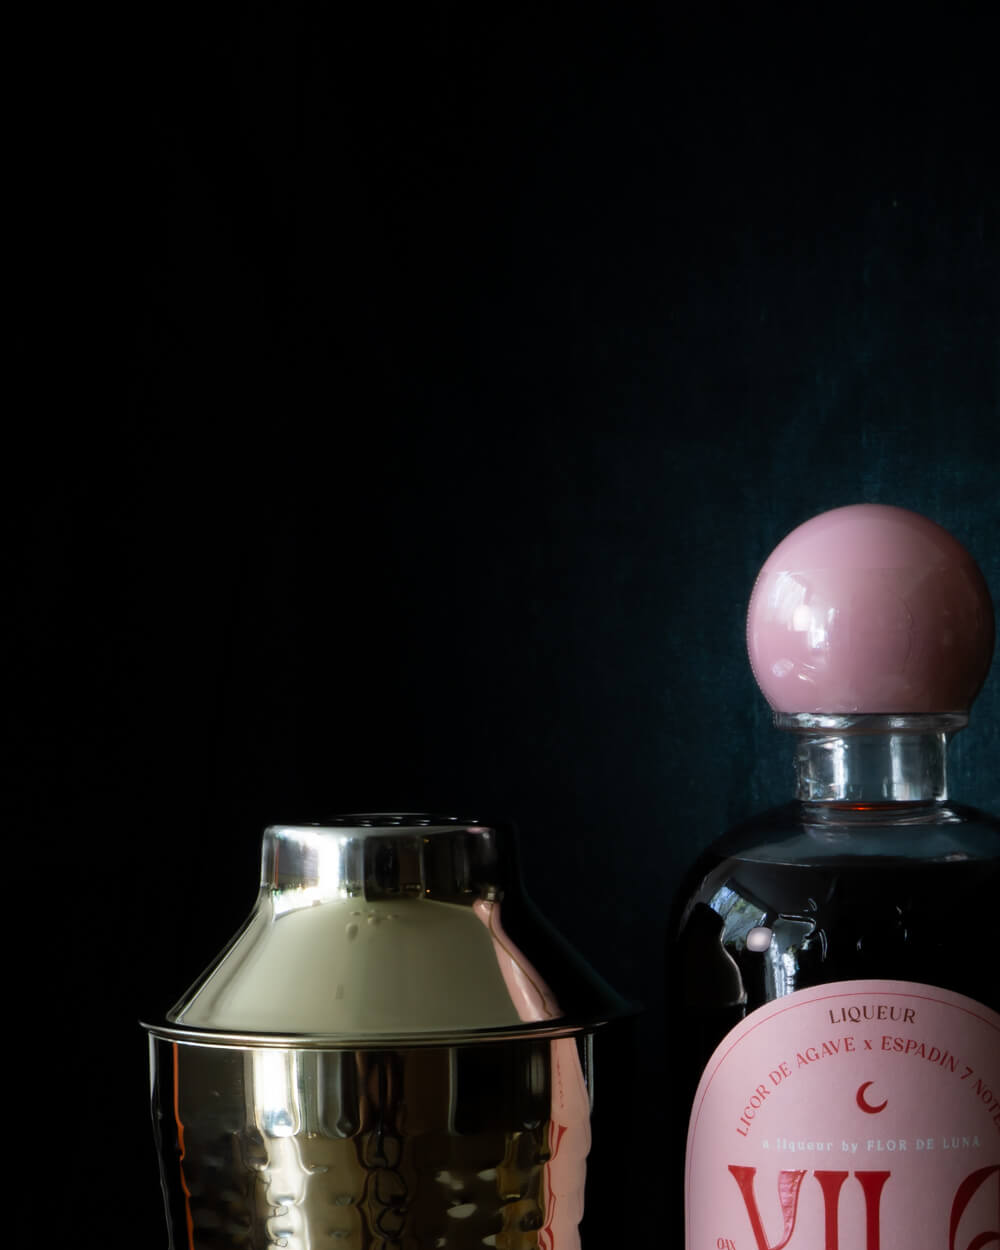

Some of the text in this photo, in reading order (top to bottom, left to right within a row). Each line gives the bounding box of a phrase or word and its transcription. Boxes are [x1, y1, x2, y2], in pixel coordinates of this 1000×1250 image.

[828, 1005, 917, 1025] LIQUEUR
[736, 1084, 771, 1137] LICOR
[768, 1062, 793, 1086] DE
[796, 1037, 856, 1068] AGAVE
[960, 1066, 974, 1080] 7
[776, 1138, 833, 1153] liqueur
[841, 1139, 858, 1153] by
[866, 1139, 907, 1151] FLOR
[915, 1138, 935, 1151] DE
[942, 1135, 982, 1150] LUNA
